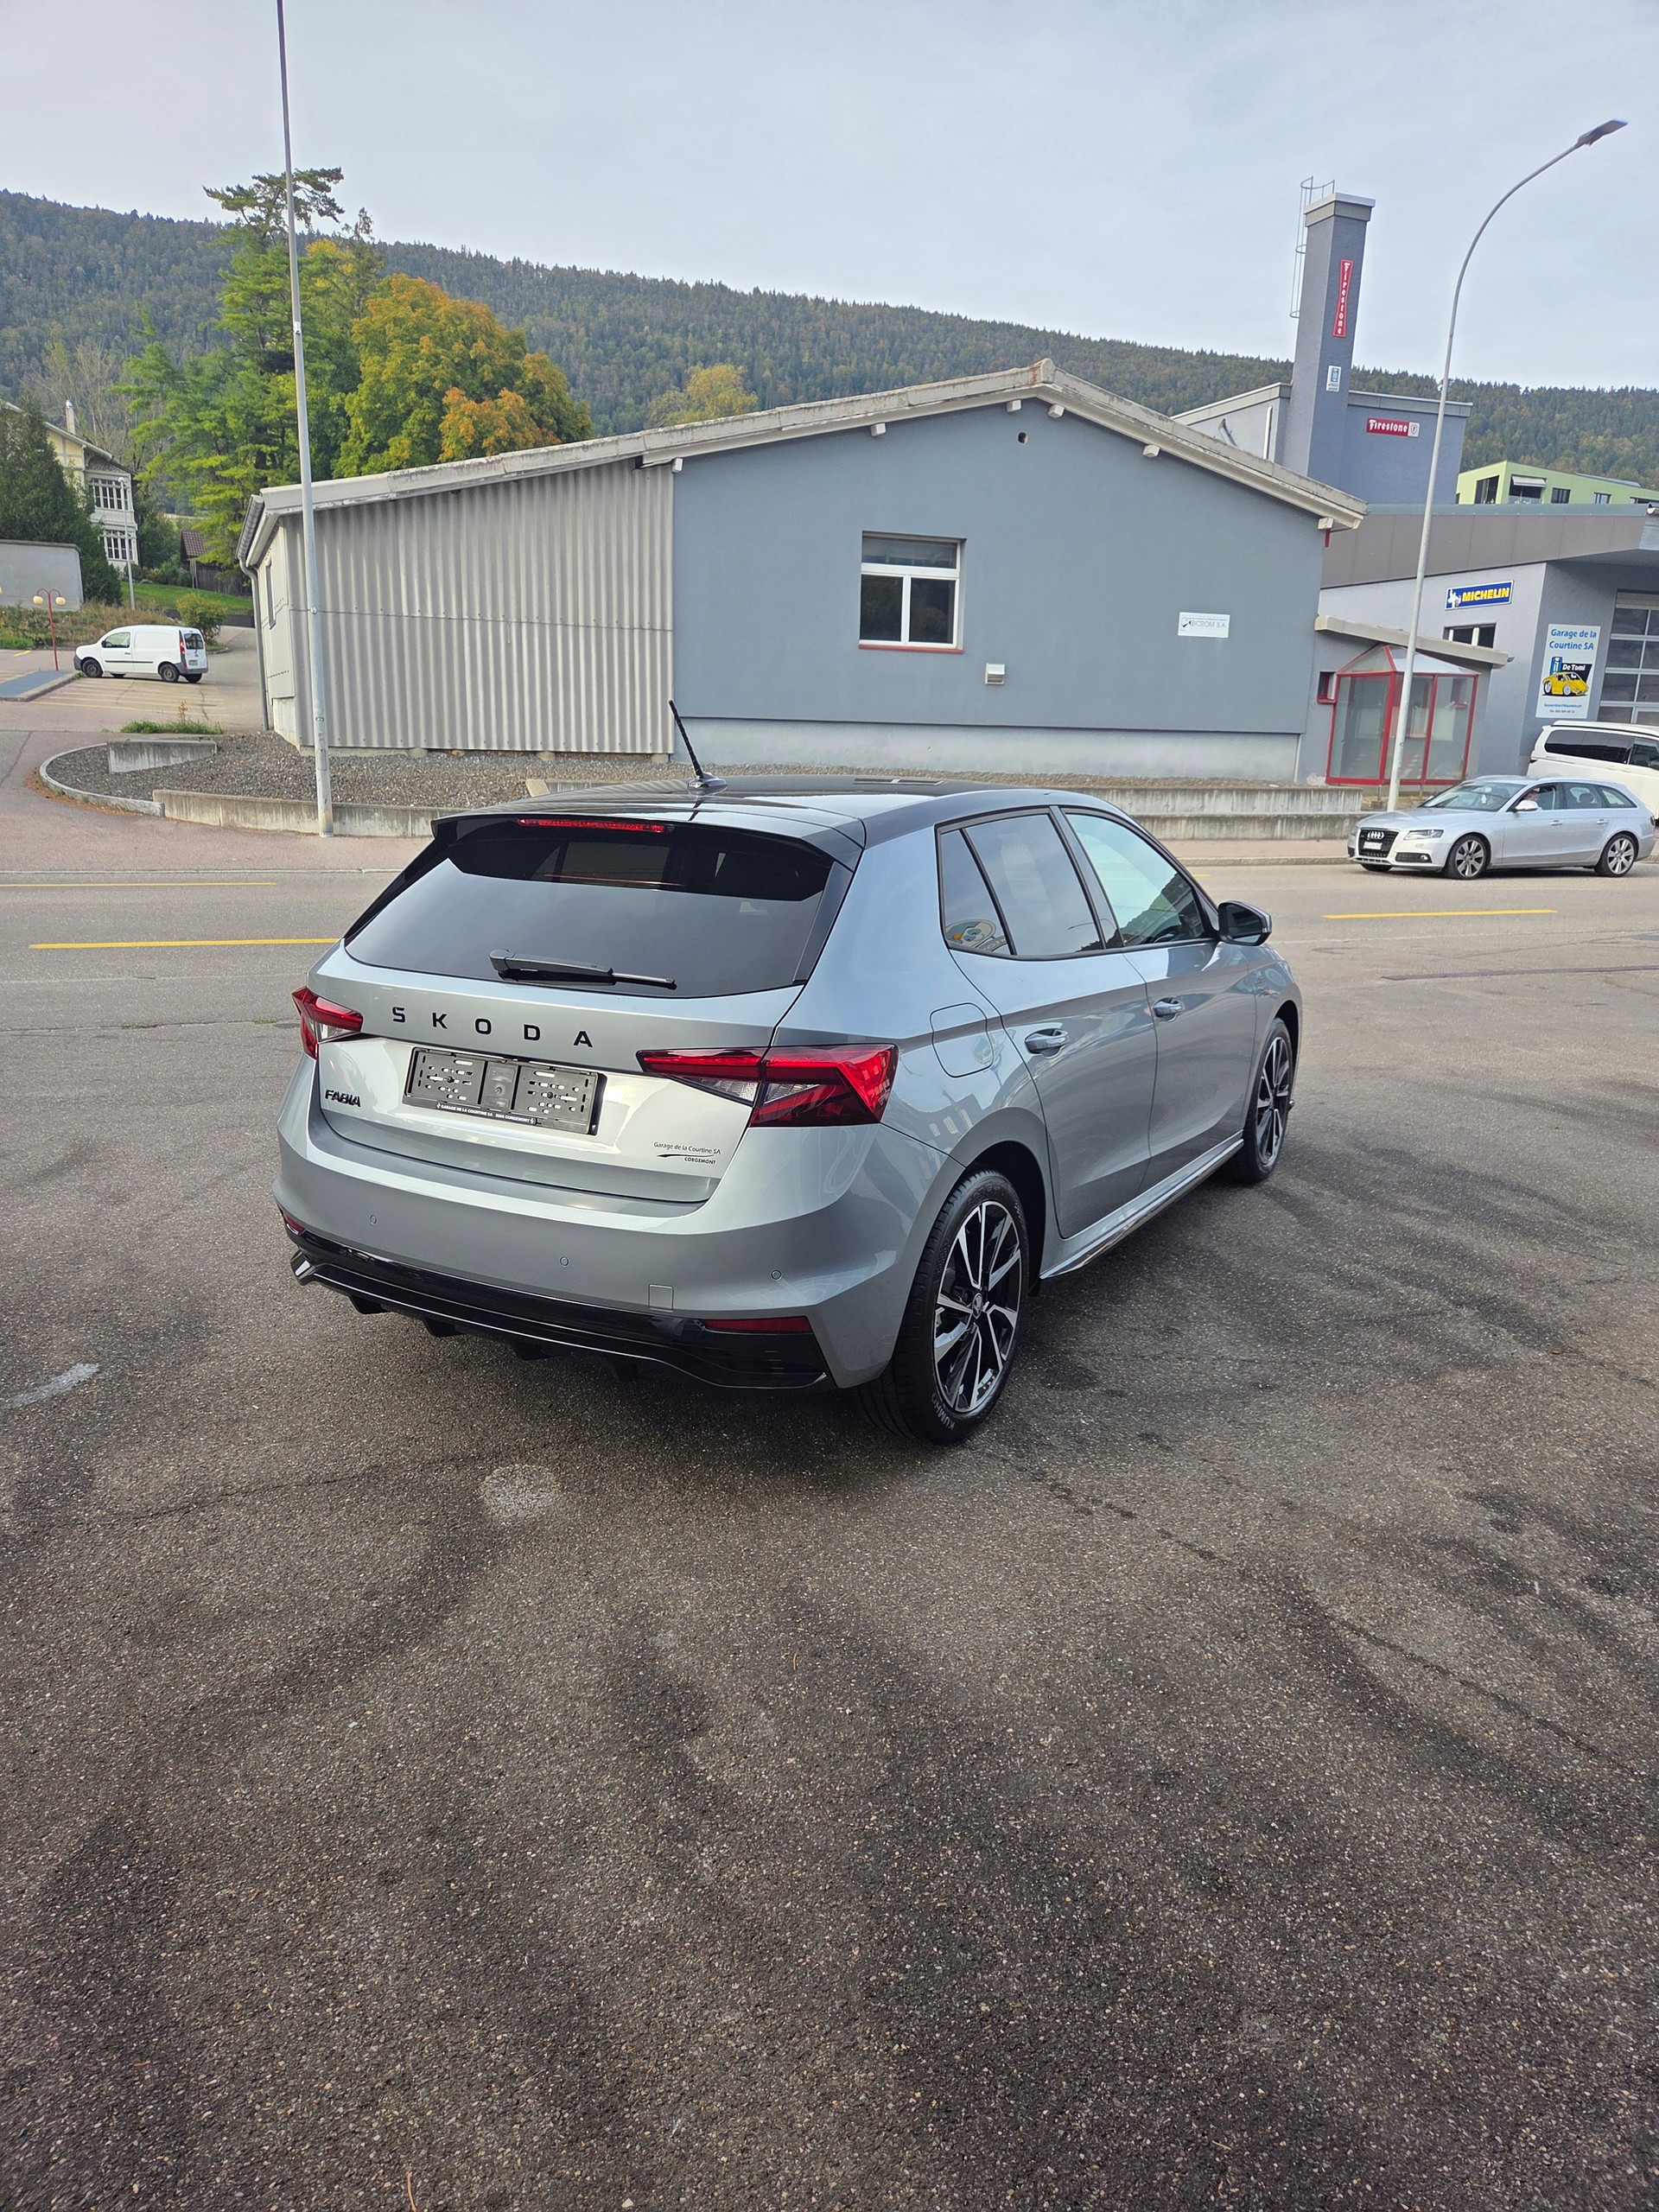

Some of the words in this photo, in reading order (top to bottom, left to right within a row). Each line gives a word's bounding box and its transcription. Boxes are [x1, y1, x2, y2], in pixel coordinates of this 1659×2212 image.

[1337, 262, 1351, 334] Firestone
[1369, 419, 1408, 433] Firestone
[1462, 588, 1510, 602] MICHELIN
[1551, 628, 1578, 639] Garage
[1549, 640, 1582, 650] Courtine
[392, 1007, 594, 1048] SKODA
[325, 1089, 361, 1108] FABIA
[653, 1141, 674, 1151] Garage
[684, 1156, 716, 1165] CORGEMONT
[931, 1392, 956, 1431] KUMHO
